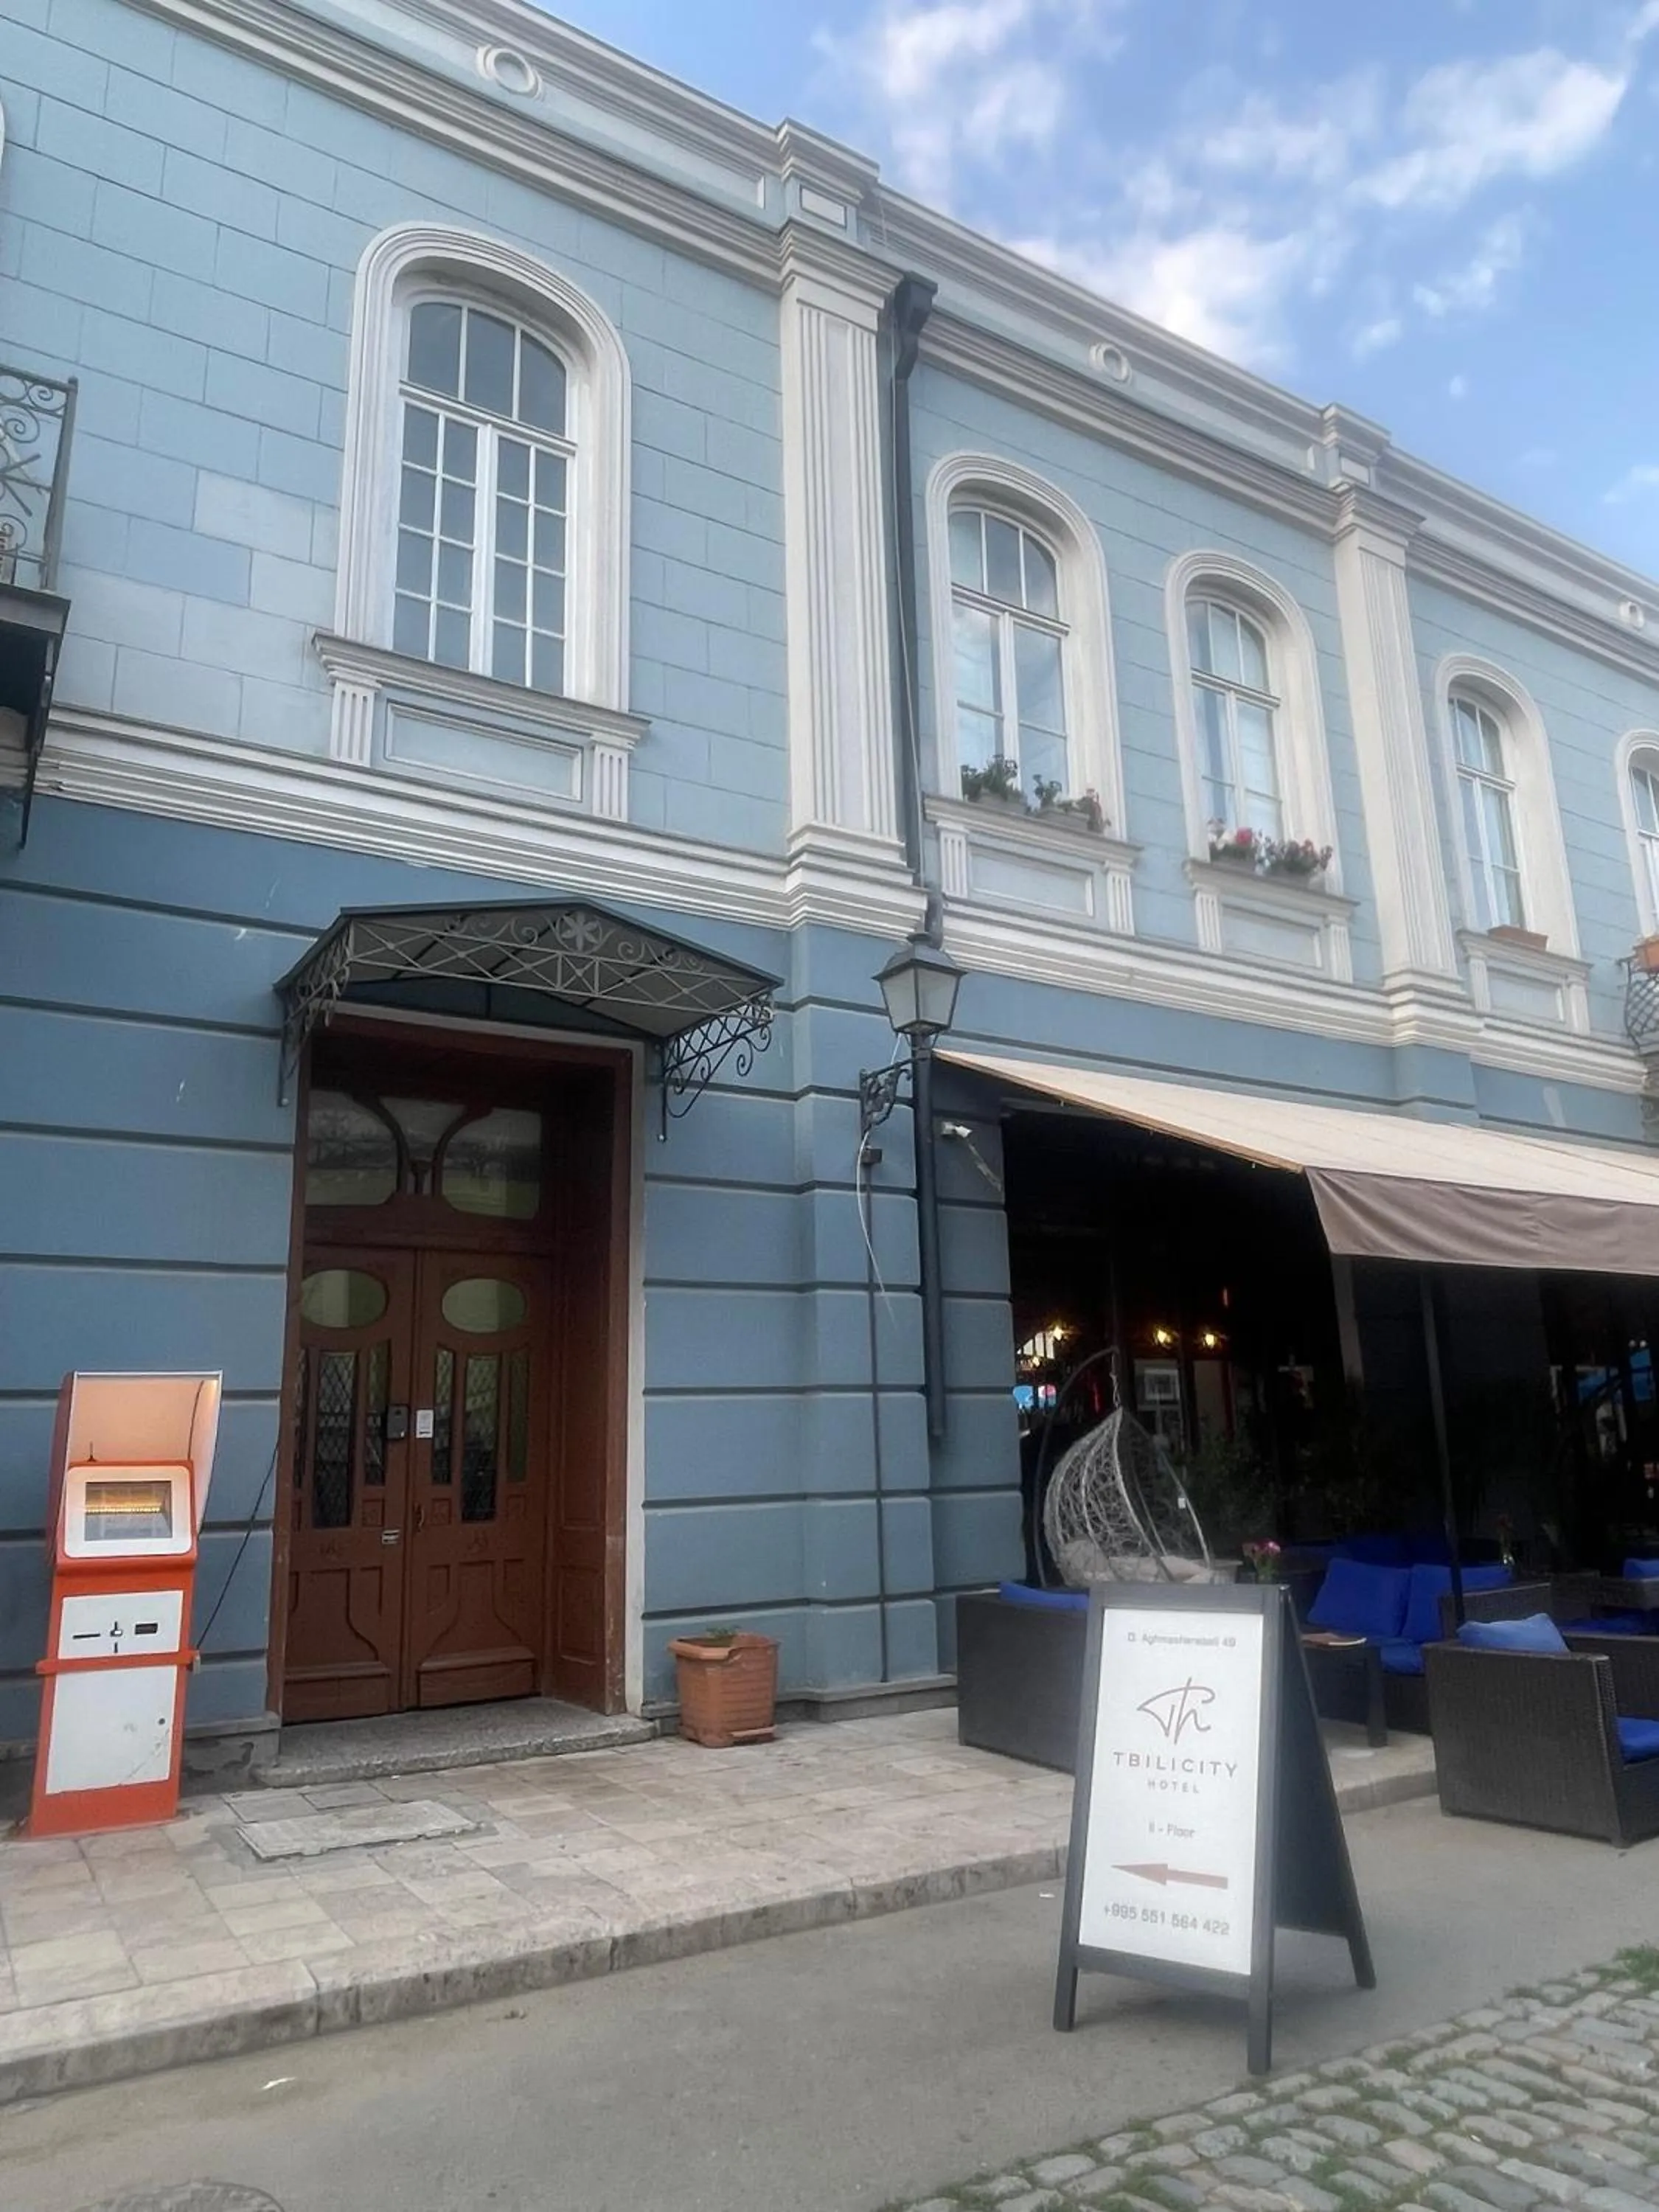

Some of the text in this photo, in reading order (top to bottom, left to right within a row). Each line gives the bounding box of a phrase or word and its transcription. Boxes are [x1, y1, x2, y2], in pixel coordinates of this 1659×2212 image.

[1113, 1751, 1238, 1778] TBILICITY
[1147, 1779, 1200, 1794] HOTEL
[1167, 1823, 1196, 1838] Floor
[1104, 1903, 1137, 1920] +995
[1203, 1919, 1230, 1935] 422
